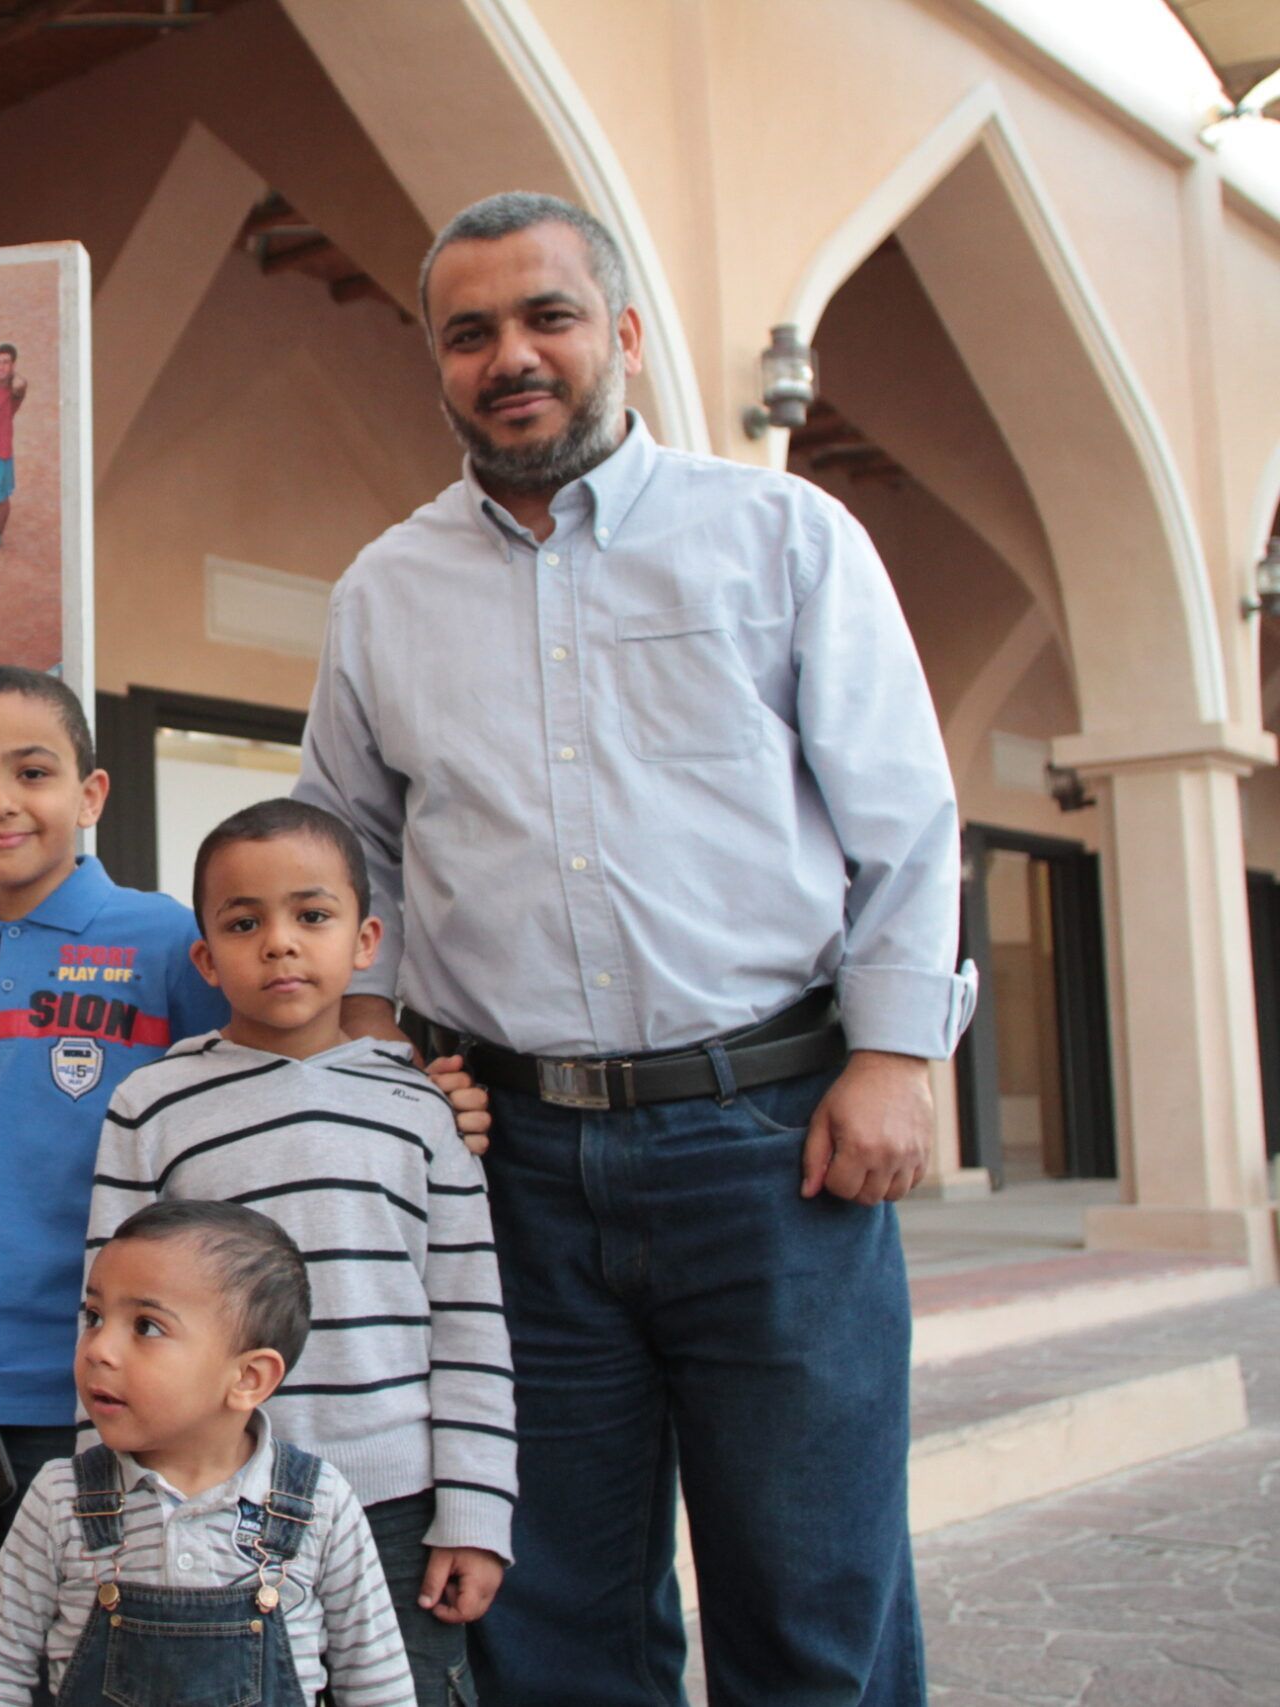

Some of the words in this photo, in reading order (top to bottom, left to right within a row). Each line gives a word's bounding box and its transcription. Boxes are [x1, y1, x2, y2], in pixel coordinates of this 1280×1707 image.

[60, 944, 137, 967] SPORT
[58, 966, 97, 981] PLAY
[104, 968, 133, 983] OFF
[29, 990, 138, 1040] SION
